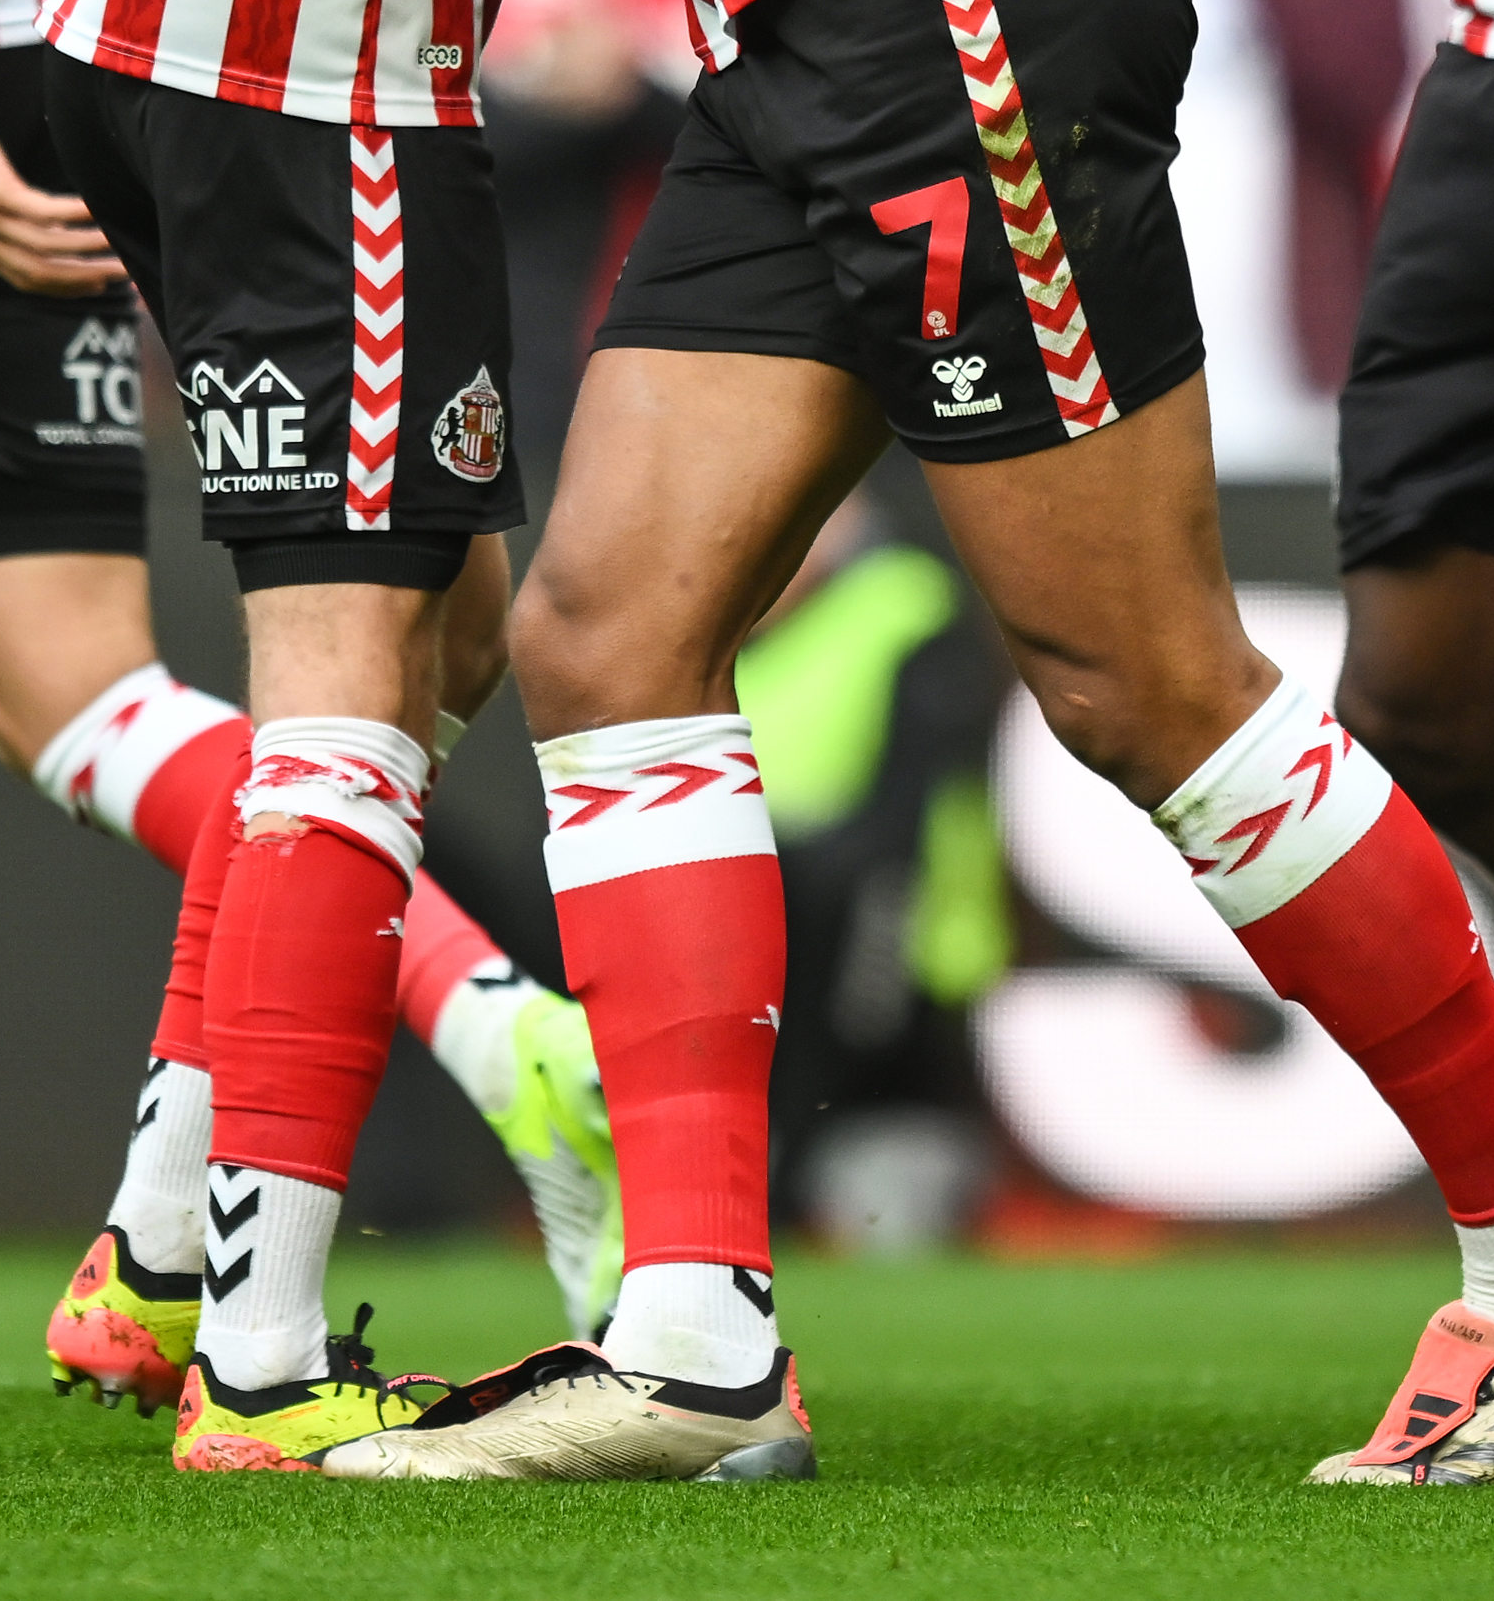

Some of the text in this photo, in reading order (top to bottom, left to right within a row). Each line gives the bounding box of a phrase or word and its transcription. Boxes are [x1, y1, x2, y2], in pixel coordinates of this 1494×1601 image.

[417, 48, 459, 65] ECO8
[869, 175, 970, 340] 7
[933, 328, 950, 337] EFL
[933, 393, 1003, 418] hummel
[202, 472, 340, 494] UCTION NE LTD
